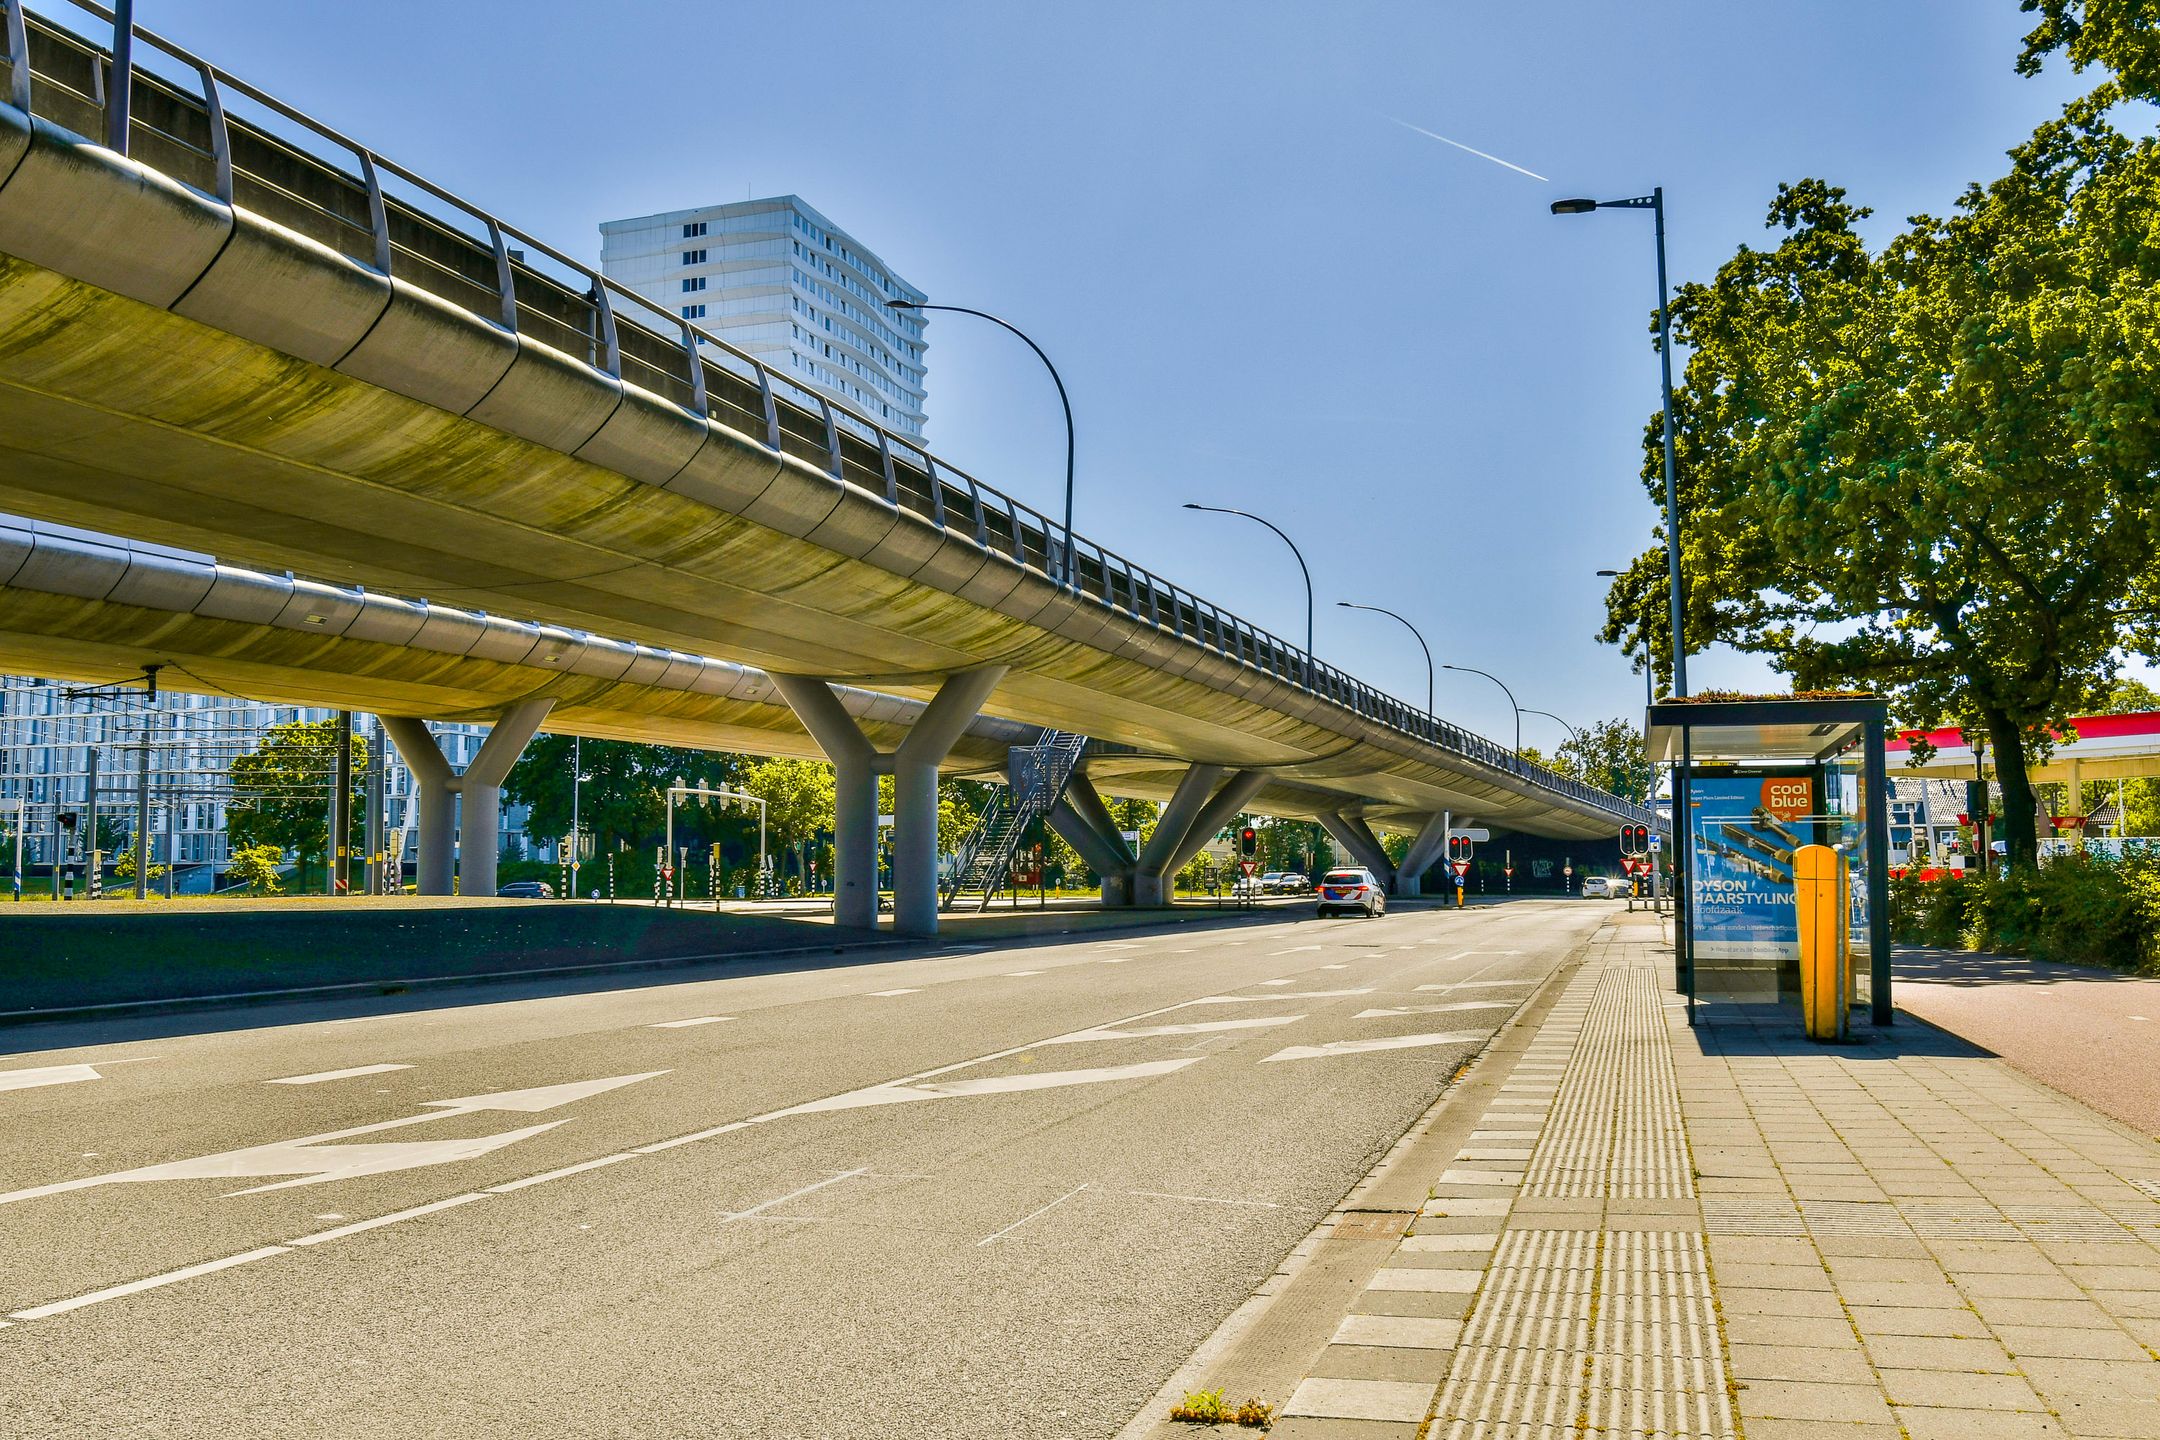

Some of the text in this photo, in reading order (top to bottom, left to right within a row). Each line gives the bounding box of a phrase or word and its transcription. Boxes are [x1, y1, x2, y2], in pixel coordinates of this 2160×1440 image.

[1770, 782, 1807, 795] cool
[1771, 795, 1808, 808] blue
[1692, 880, 1747, 892] DYSON
